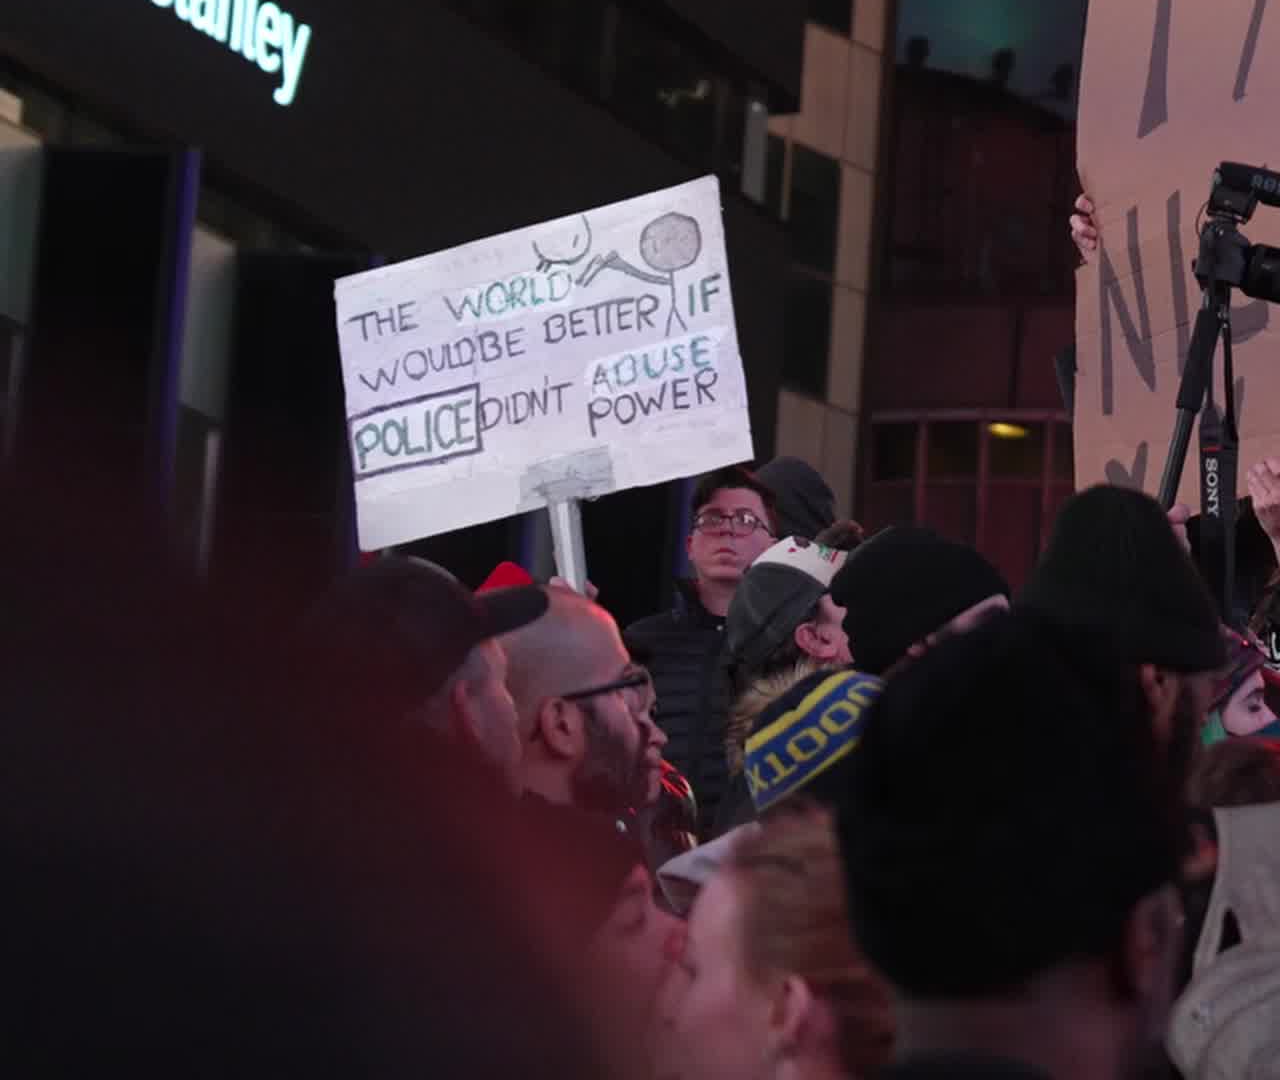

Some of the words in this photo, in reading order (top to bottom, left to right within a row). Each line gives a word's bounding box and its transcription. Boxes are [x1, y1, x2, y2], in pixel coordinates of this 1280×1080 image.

[345, 301, 419, 341] THE
[444, 271, 571, 321] WORLD
[359, 337, 475, 392] WOULD
[477, 327, 526, 362] BE
[544, 294, 659, 344] BETTER
[688, 274, 721, 316] IF
[355, 399, 474, 470] POLICE
[592, 336, 710, 394] ABUSE
[588, 367, 718, 437] POWER
[1205, 457, 1220, 518] SONY
